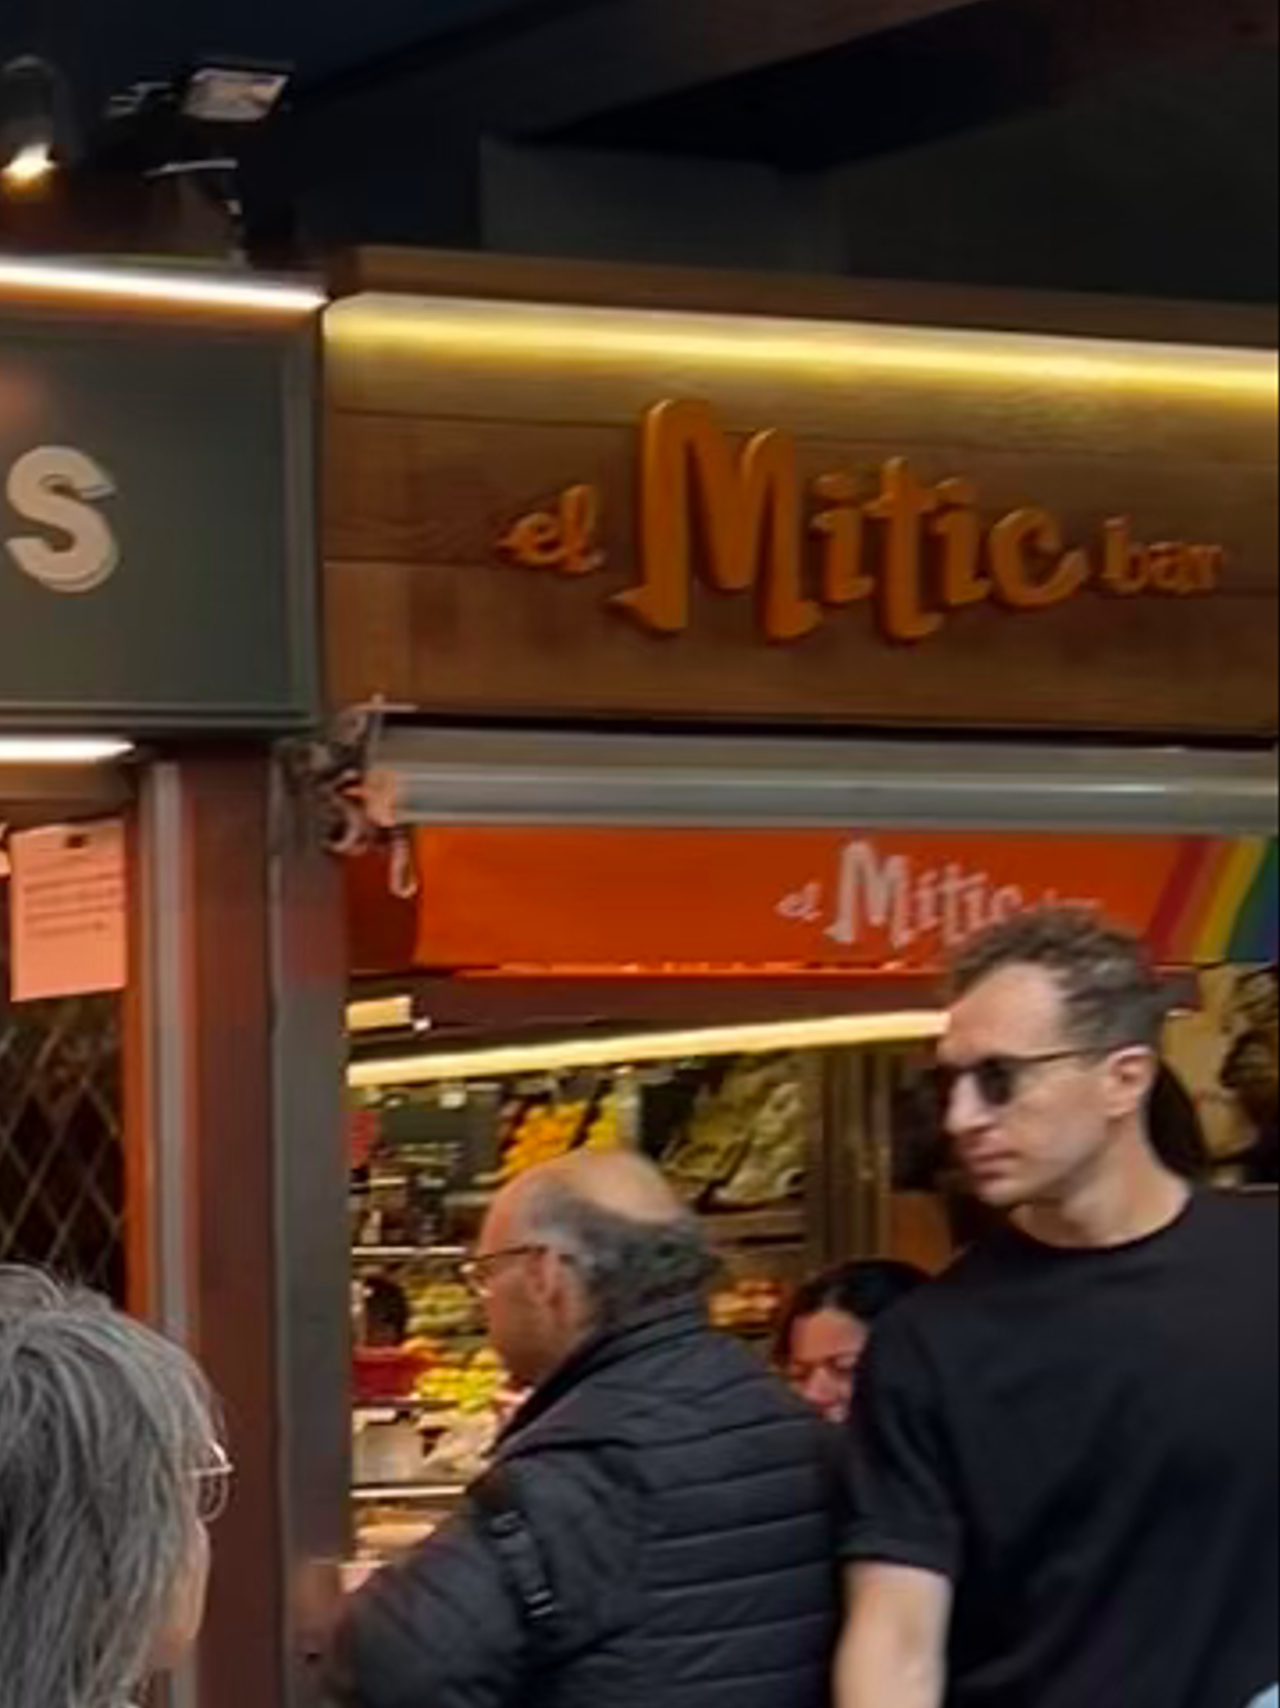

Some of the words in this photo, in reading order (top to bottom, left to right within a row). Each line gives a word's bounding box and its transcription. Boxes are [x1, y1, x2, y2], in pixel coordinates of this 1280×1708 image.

[496, 485, 604, 572] el
[1102, 514, 1224, 594] bar
[774, 882, 822, 921] el
